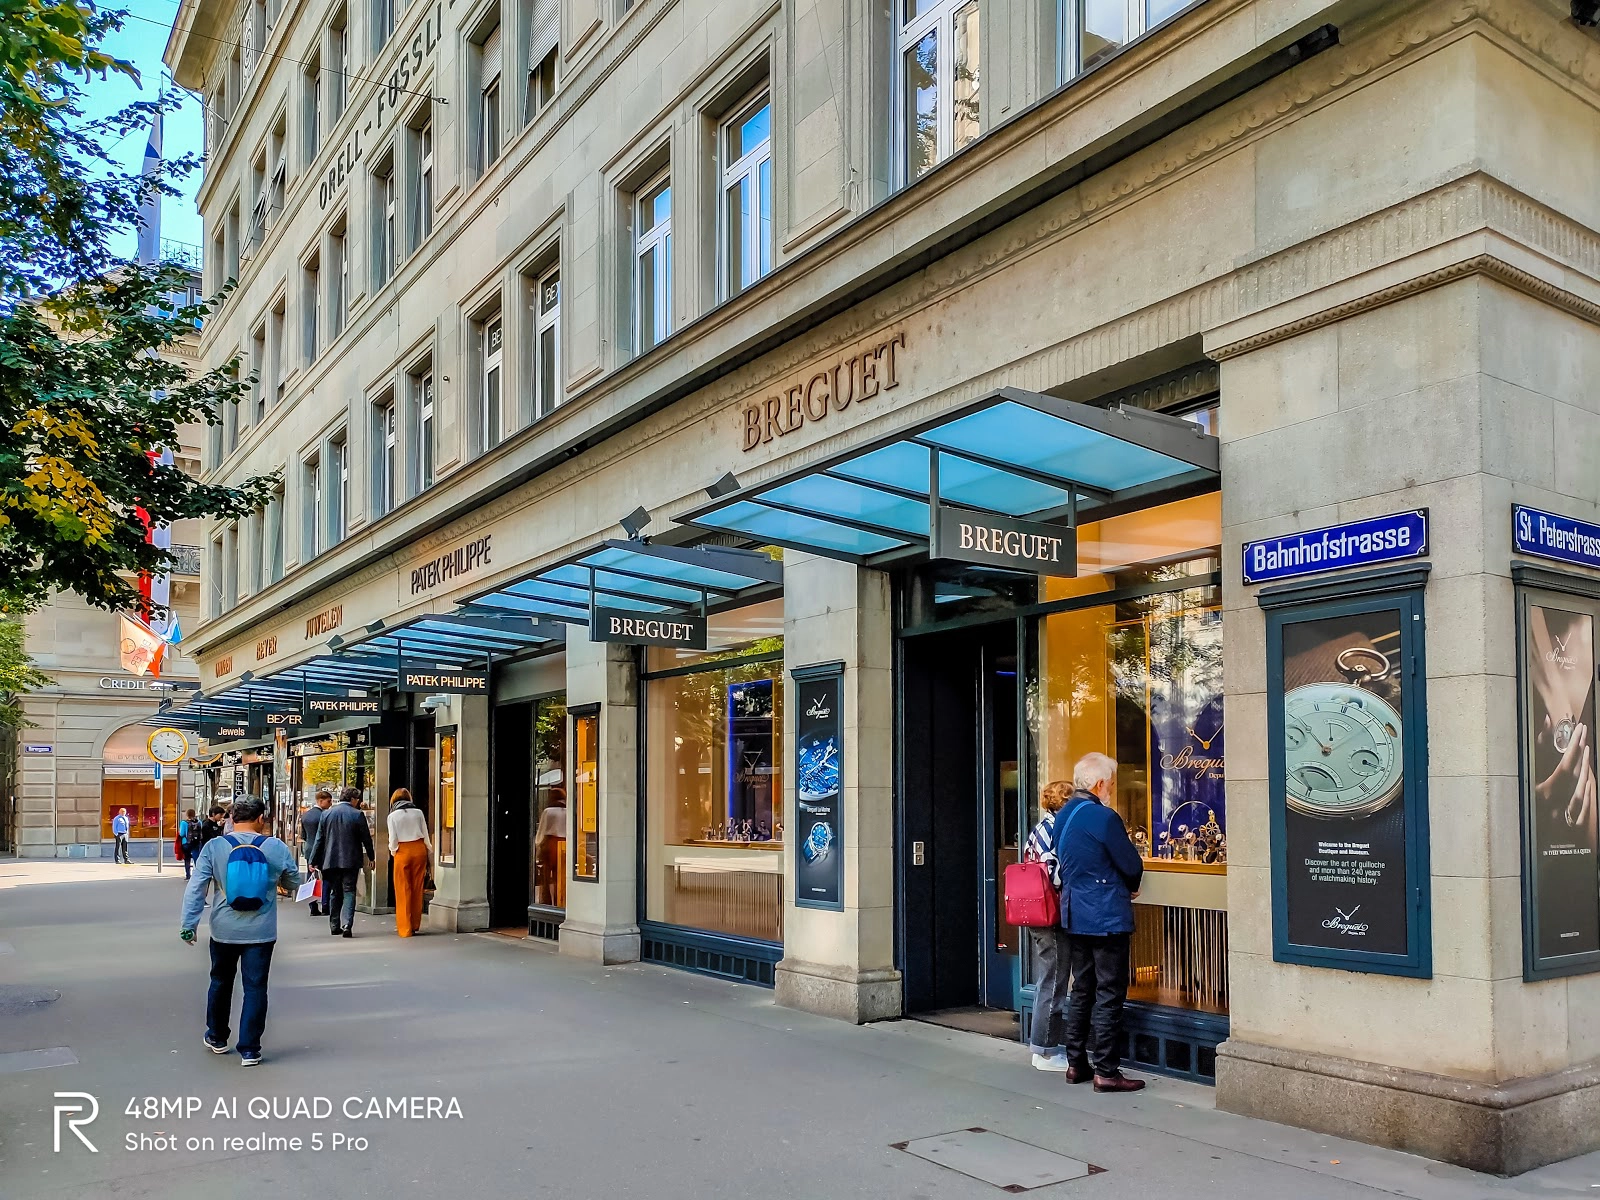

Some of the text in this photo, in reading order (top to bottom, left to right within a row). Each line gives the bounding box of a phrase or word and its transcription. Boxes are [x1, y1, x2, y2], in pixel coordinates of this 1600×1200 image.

[319, 129, 363, 210] ORELL
[741, 333, 906, 453] BREGUET
[1520, 511, 1535, 543] St.
[958, 522, 1062, 563] BREGUET
[1253, 523, 1410, 573] Bahnhofstrasse
[411, 534, 492, 595] PATEK PHILIPPE
[609, 616, 694, 641] BREGUET
[100, 677, 148, 690] CREDIT
[406, 674, 486, 689] PATEK PHILIPPE
[310, 700, 379, 712] PATEK PHILIPPE
[267, 714, 303, 725] BEYER
[217, 727, 245, 736] Jewels
[235, 771, 243, 796] OFFEN
[1304, 858, 1329, 866] Discover
[1330, 859, 1340, 867] the
[1350, 860, 1358, 868] of
[1318, 875, 1356, 885] watchmaking
[1356, 877, 1379, 886] history.
[1351, 868, 1364, 876] 240
[1364, 870, 1381, 878] years
[1321, 916, 1369, 935] Breguet
